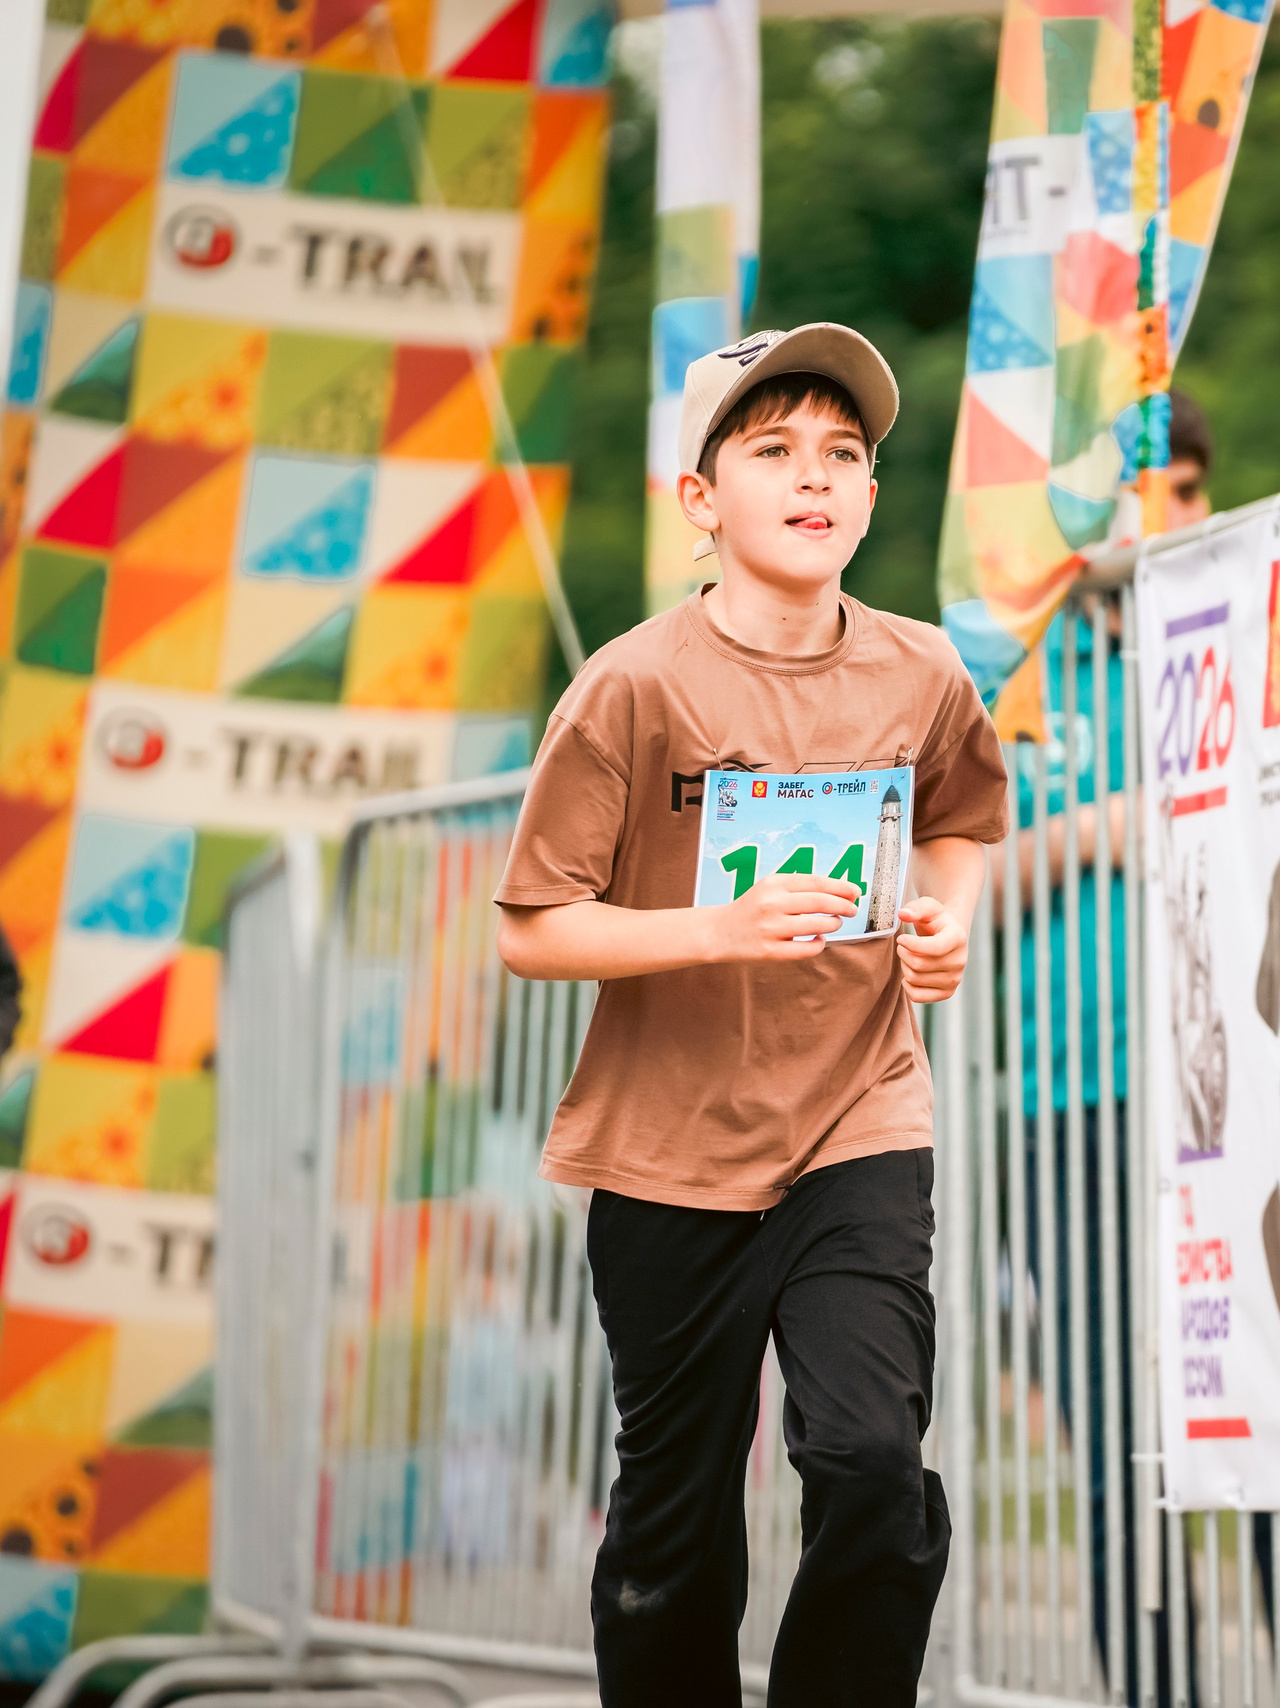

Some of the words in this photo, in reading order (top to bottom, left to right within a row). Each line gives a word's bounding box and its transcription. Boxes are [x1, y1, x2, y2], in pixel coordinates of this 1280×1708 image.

[1157, 646, 1235, 780] 2026
[718, 780, 738, 788] 2026
[778, 781, 805, 789] ЗАБЕГ
[777, 789, 815, 798] МАГАС
